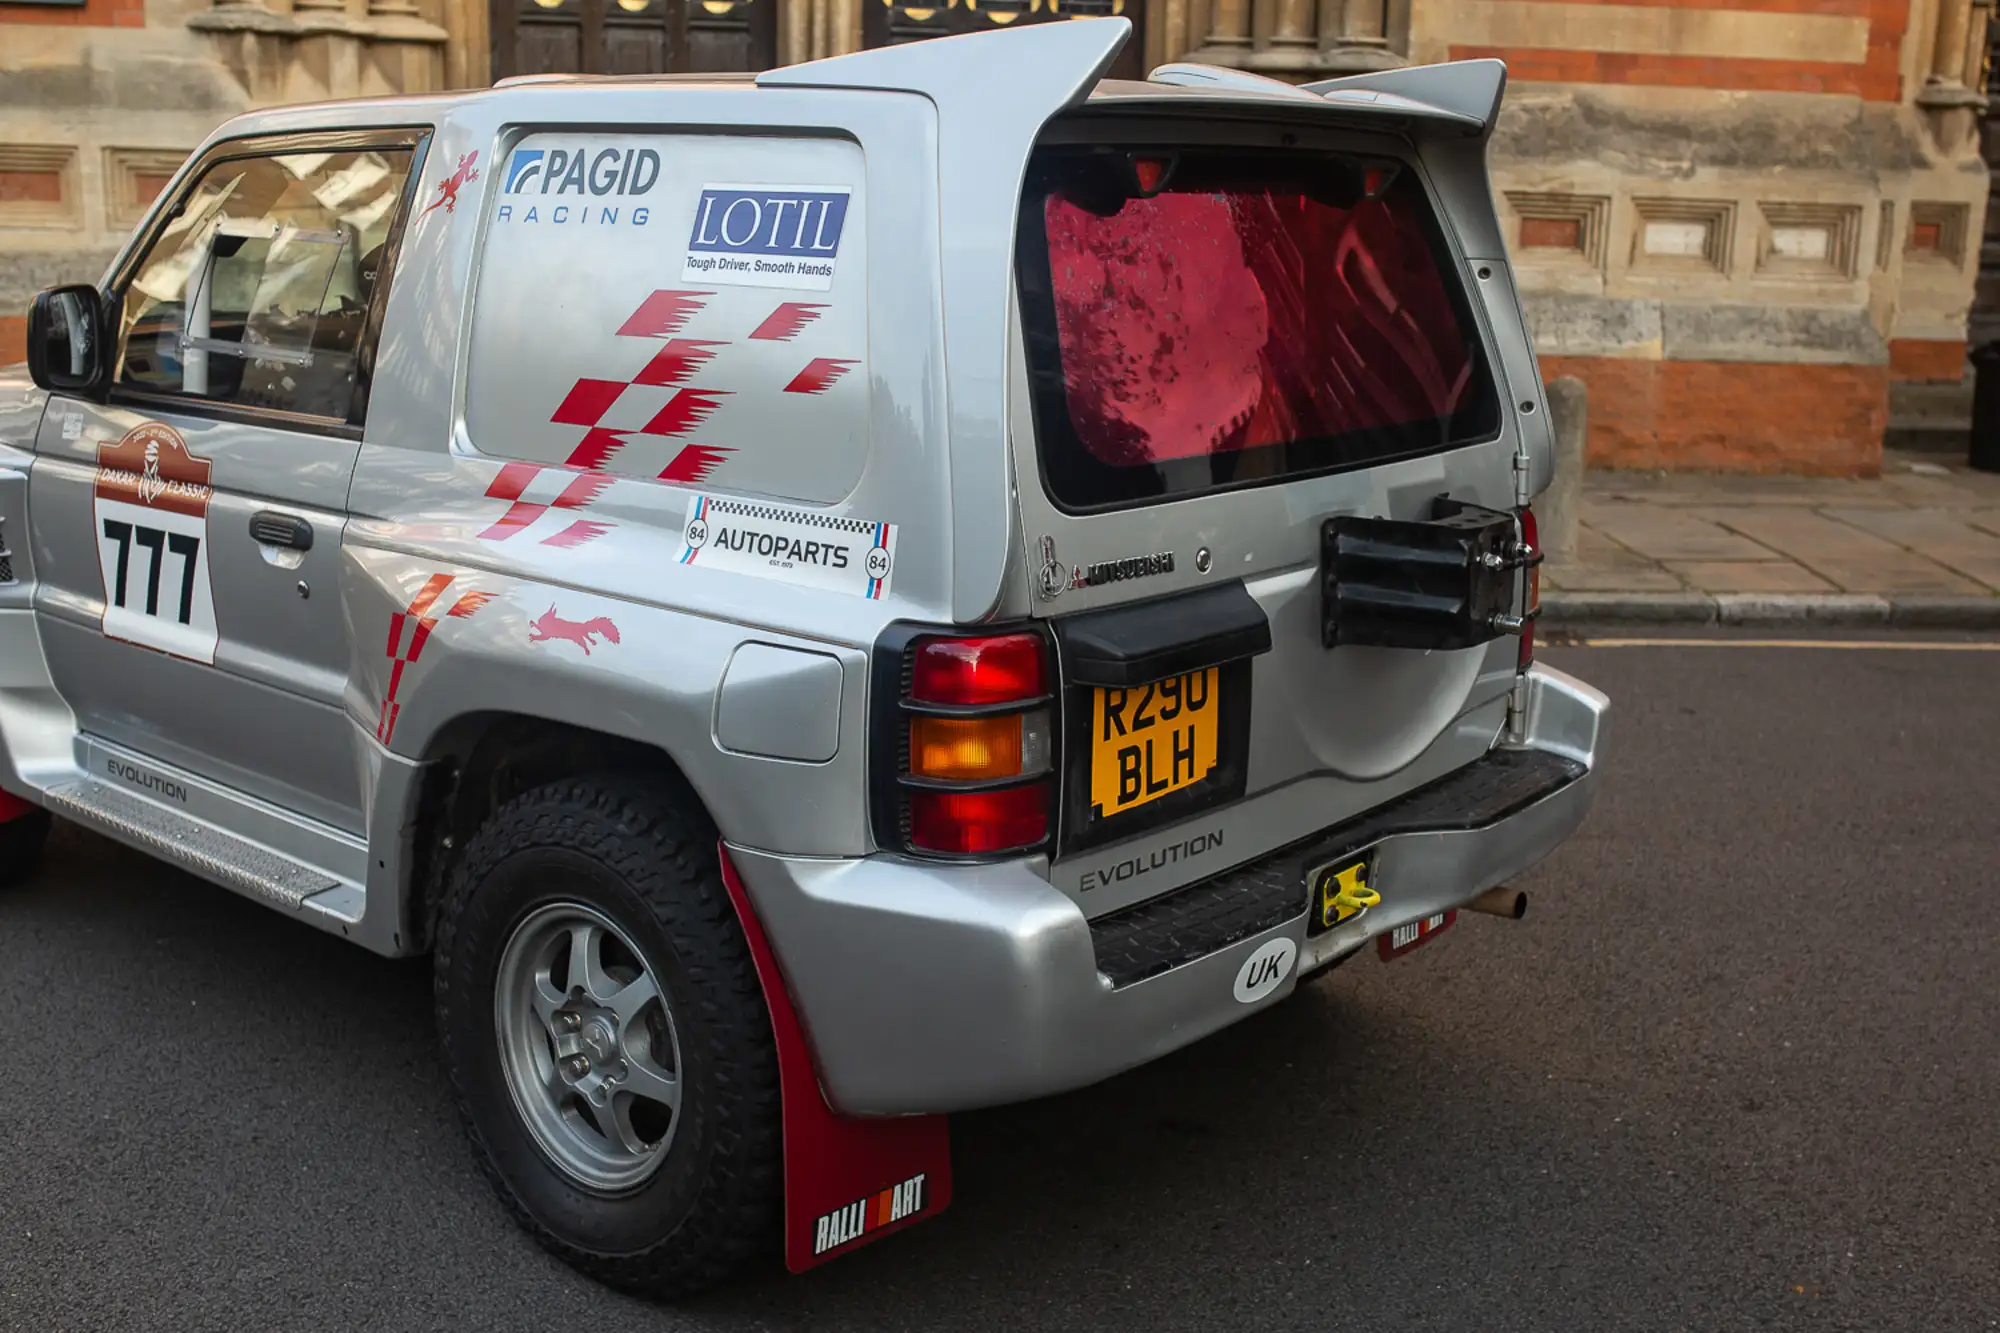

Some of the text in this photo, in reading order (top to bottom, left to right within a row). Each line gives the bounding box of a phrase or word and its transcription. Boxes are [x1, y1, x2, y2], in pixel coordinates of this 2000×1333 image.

[541, 148, 660, 196] PAGID
[498, 206, 649, 226] RACING
[694, 196, 835, 251] LOTIL
[687, 256, 832, 277] Tough Driver, Smooth Hands
[101, 468, 209, 500] DAKAR CLASSIC
[688, 527, 705, 541] 84
[713, 527, 849, 569] AUTOPARTS
[103, 519, 200, 625] 777
[868, 554, 887, 571] 84
[1087, 550, 1175, 586] MITSUBISHI
[1103, 671, 1208, 741] R290
[107, 758, 188, 803] EVOLUTION
[1117, 724, 1195, 806] BLH
[1080, 829, 1224, 892] EVOLUTION
[1246, 950, 1286, 989] UK
